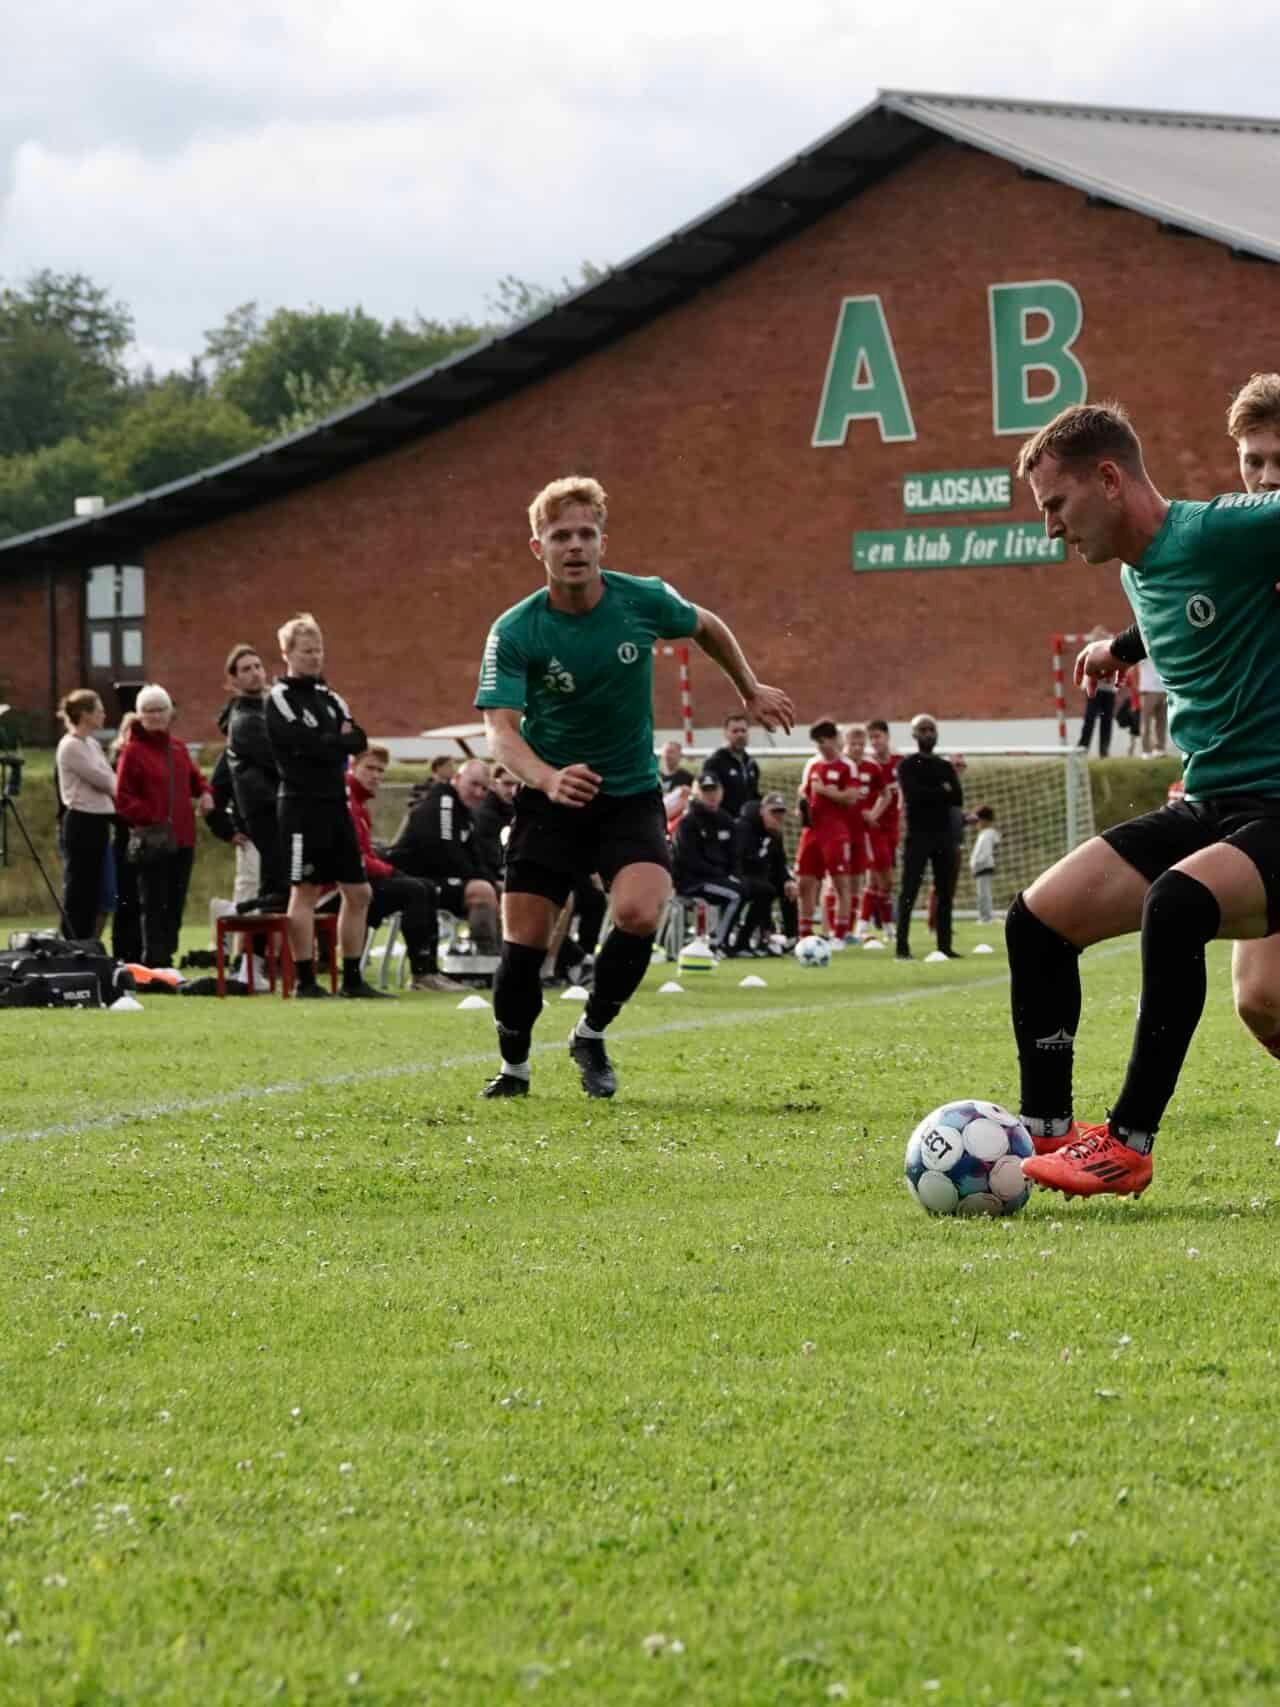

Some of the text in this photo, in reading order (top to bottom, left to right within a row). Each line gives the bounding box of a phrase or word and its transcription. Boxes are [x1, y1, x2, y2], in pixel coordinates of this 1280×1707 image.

[904, 475, 1010, 506] GLADSAXE
[903, 533, 950, 562] klub
[959, 530, 998, 564] for
